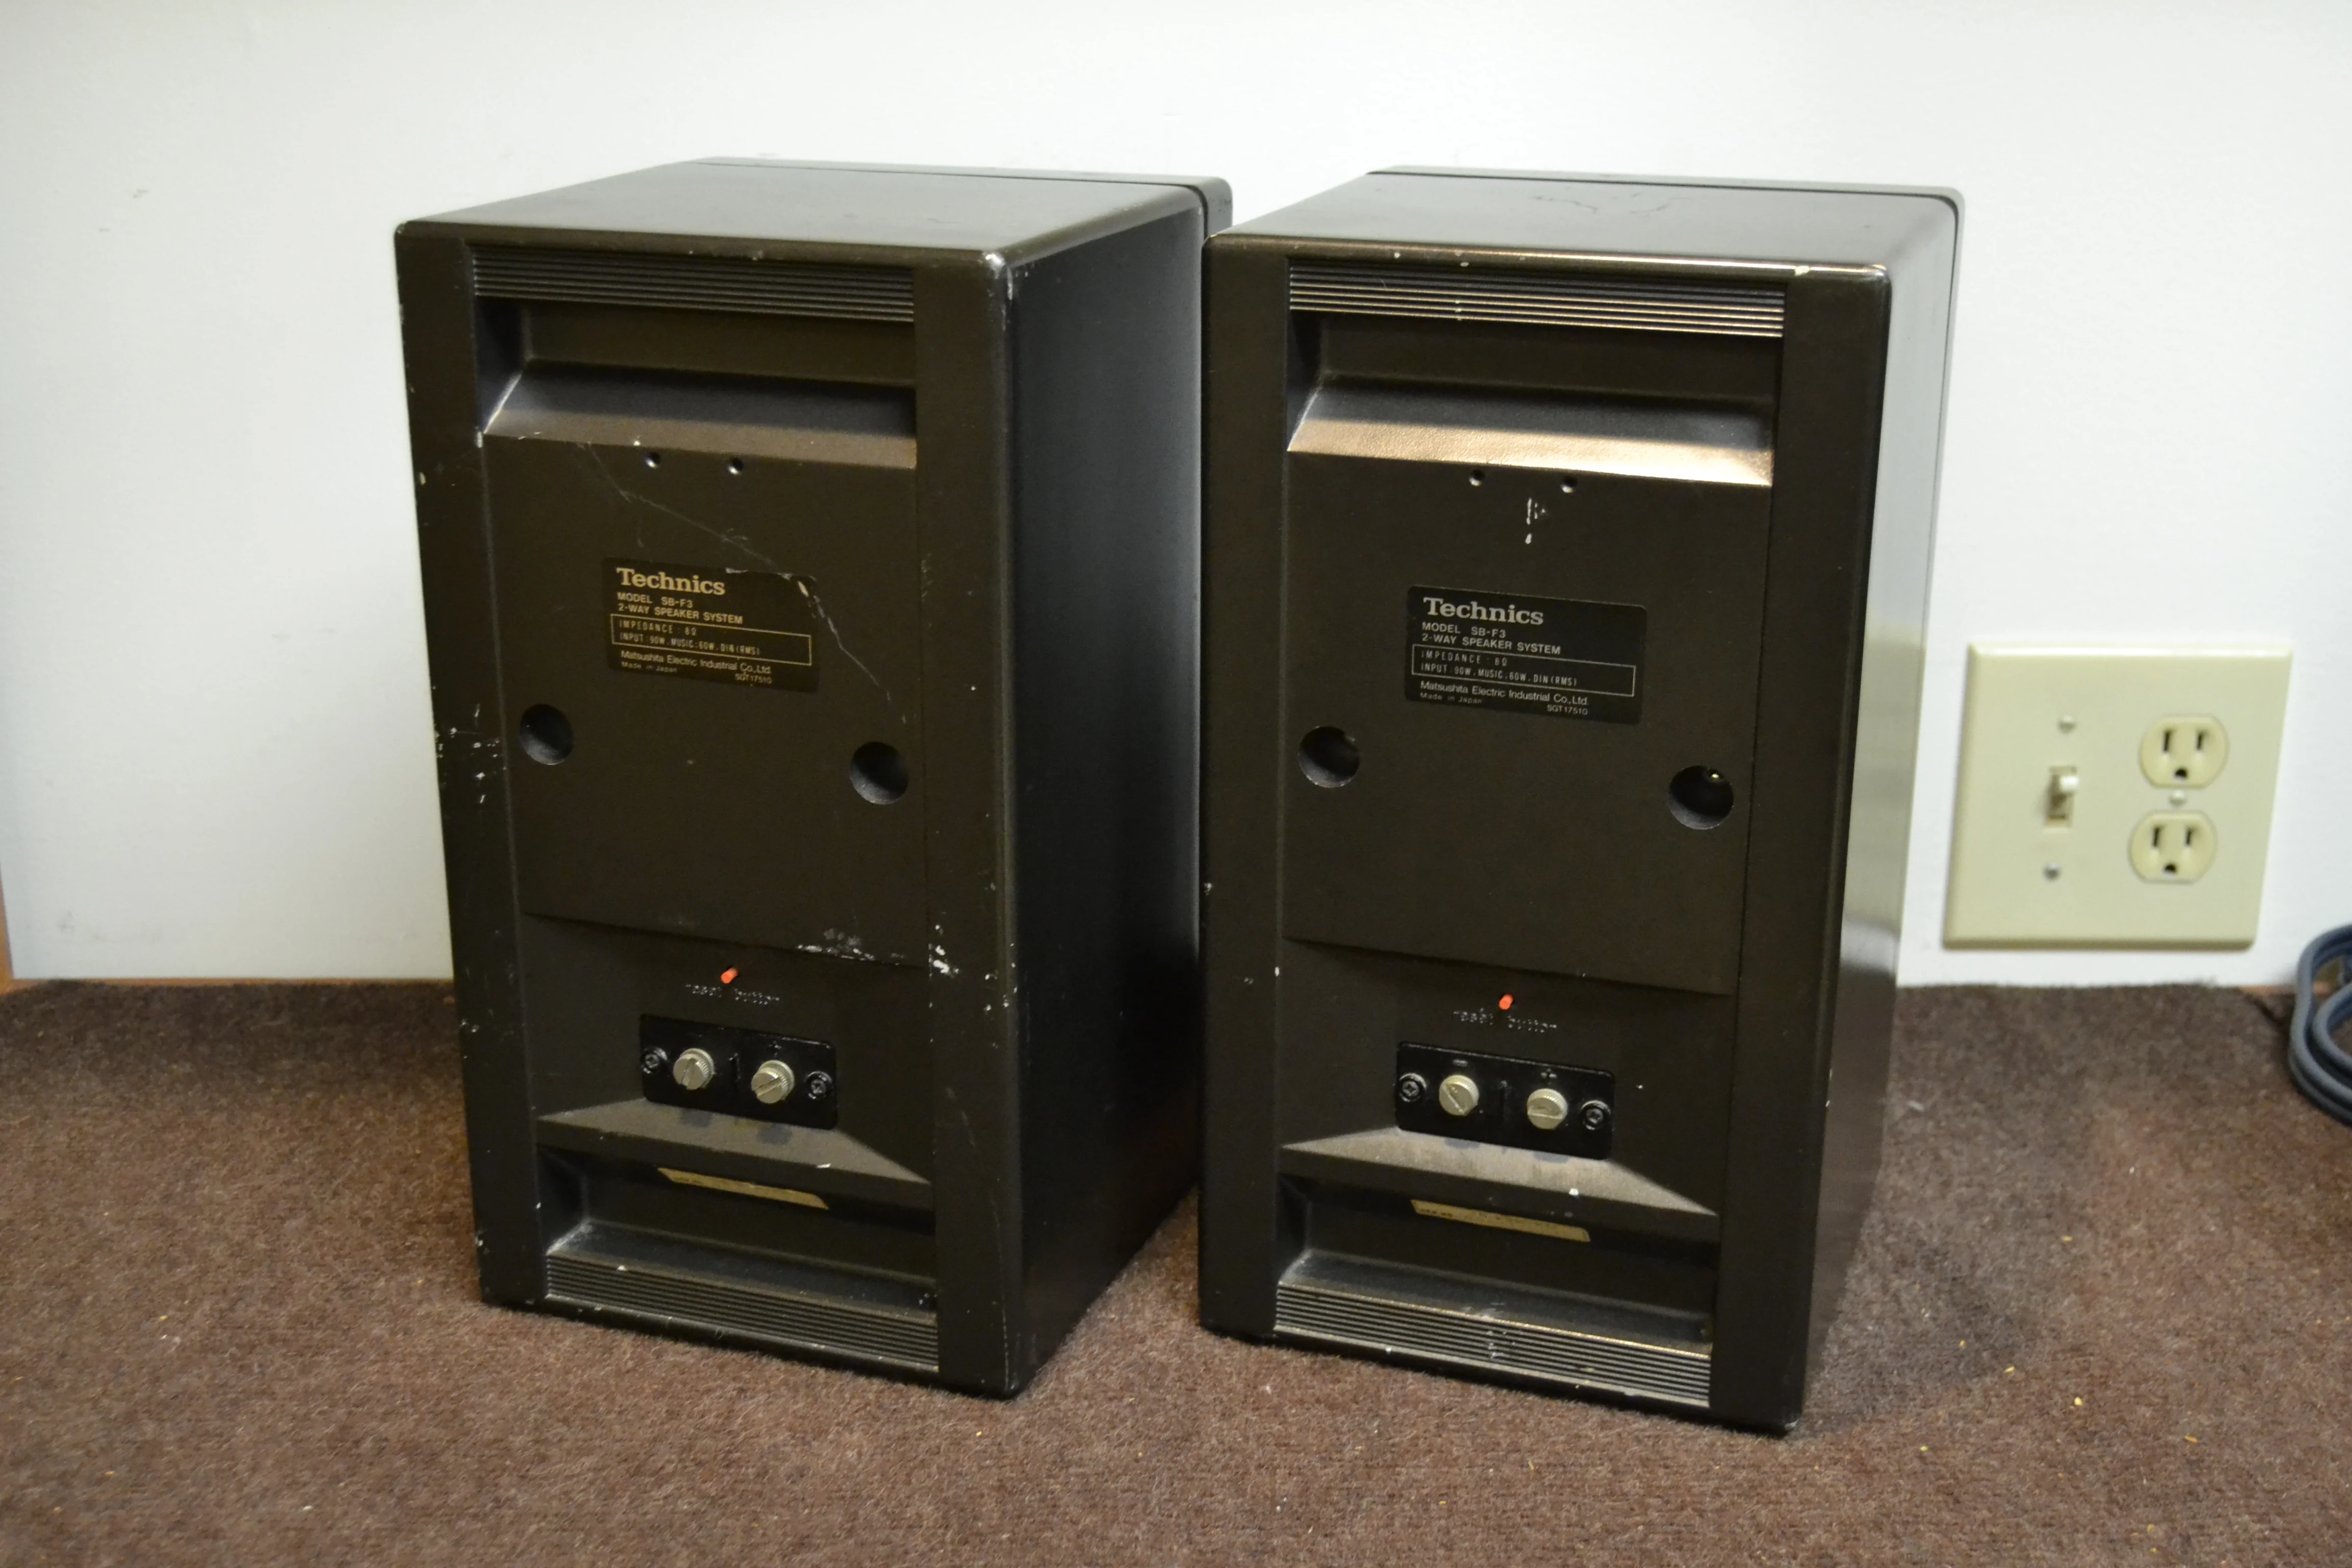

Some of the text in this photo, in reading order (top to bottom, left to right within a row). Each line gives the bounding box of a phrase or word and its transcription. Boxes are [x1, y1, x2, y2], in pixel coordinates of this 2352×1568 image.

[616, 567, 725, 595] Technics
[617, 592, 693, 608] MODEL SB-F3
[1423, 596, 1544, 625] Technics
[618, 603, 743, 624] 2-WAY SPEAKER SYSTEM
[1422, 621, 1506, 638] MODEL SB-F3
[1422, 633, 1561, 655] 2-WAY SPEAKER SYSTEM
[621, 650, 664, 663] Matsushita
[667, 654, 698, 667] Electric
[700, 659, 738, 671] Industrial
[1420, 680, 1468, 694] Matsushita
[1472, 685, 1506, 698] Electric
[1509, 690, 1551, 702] Industrial
[1420, 692, 1443, 700] Made
[1458, 696, 1483, 704] Japan
